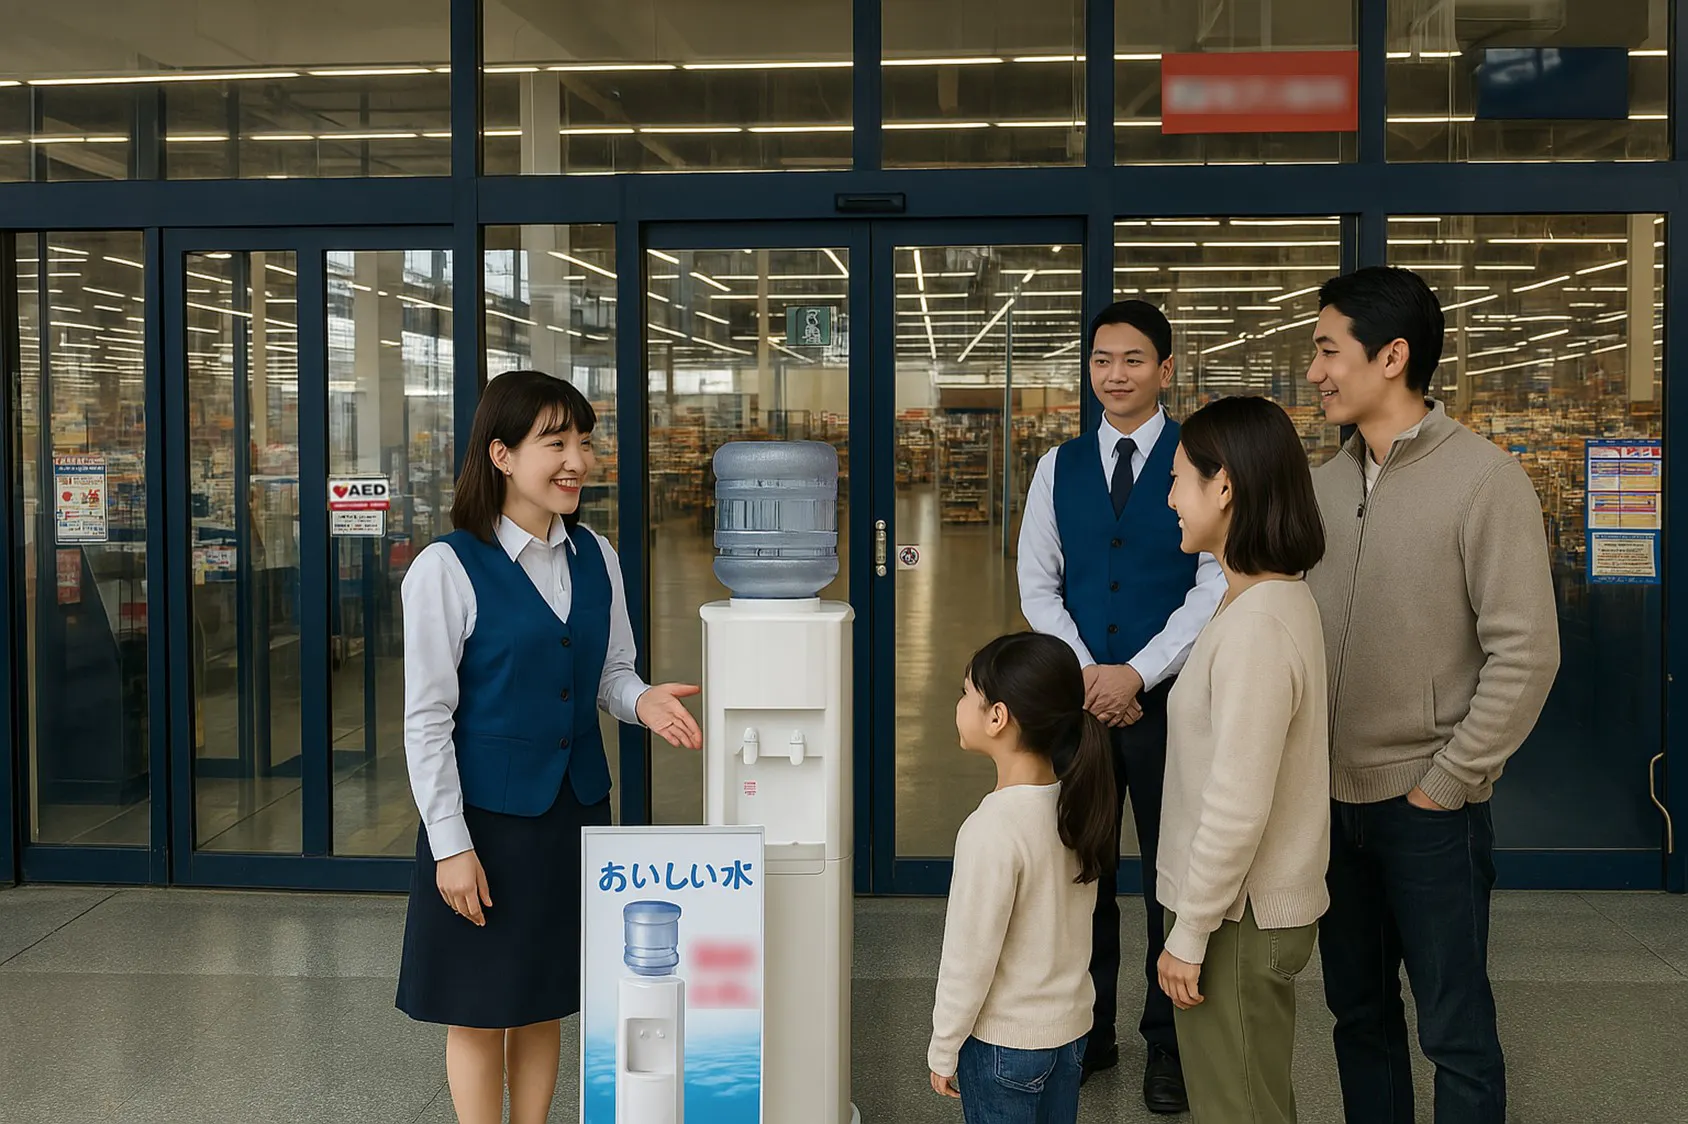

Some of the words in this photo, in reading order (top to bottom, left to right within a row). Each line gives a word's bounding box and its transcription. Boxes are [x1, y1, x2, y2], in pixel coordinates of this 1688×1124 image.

[348, 484, 386, 496] AED
[599, 860, 753, 892] おいしい水
